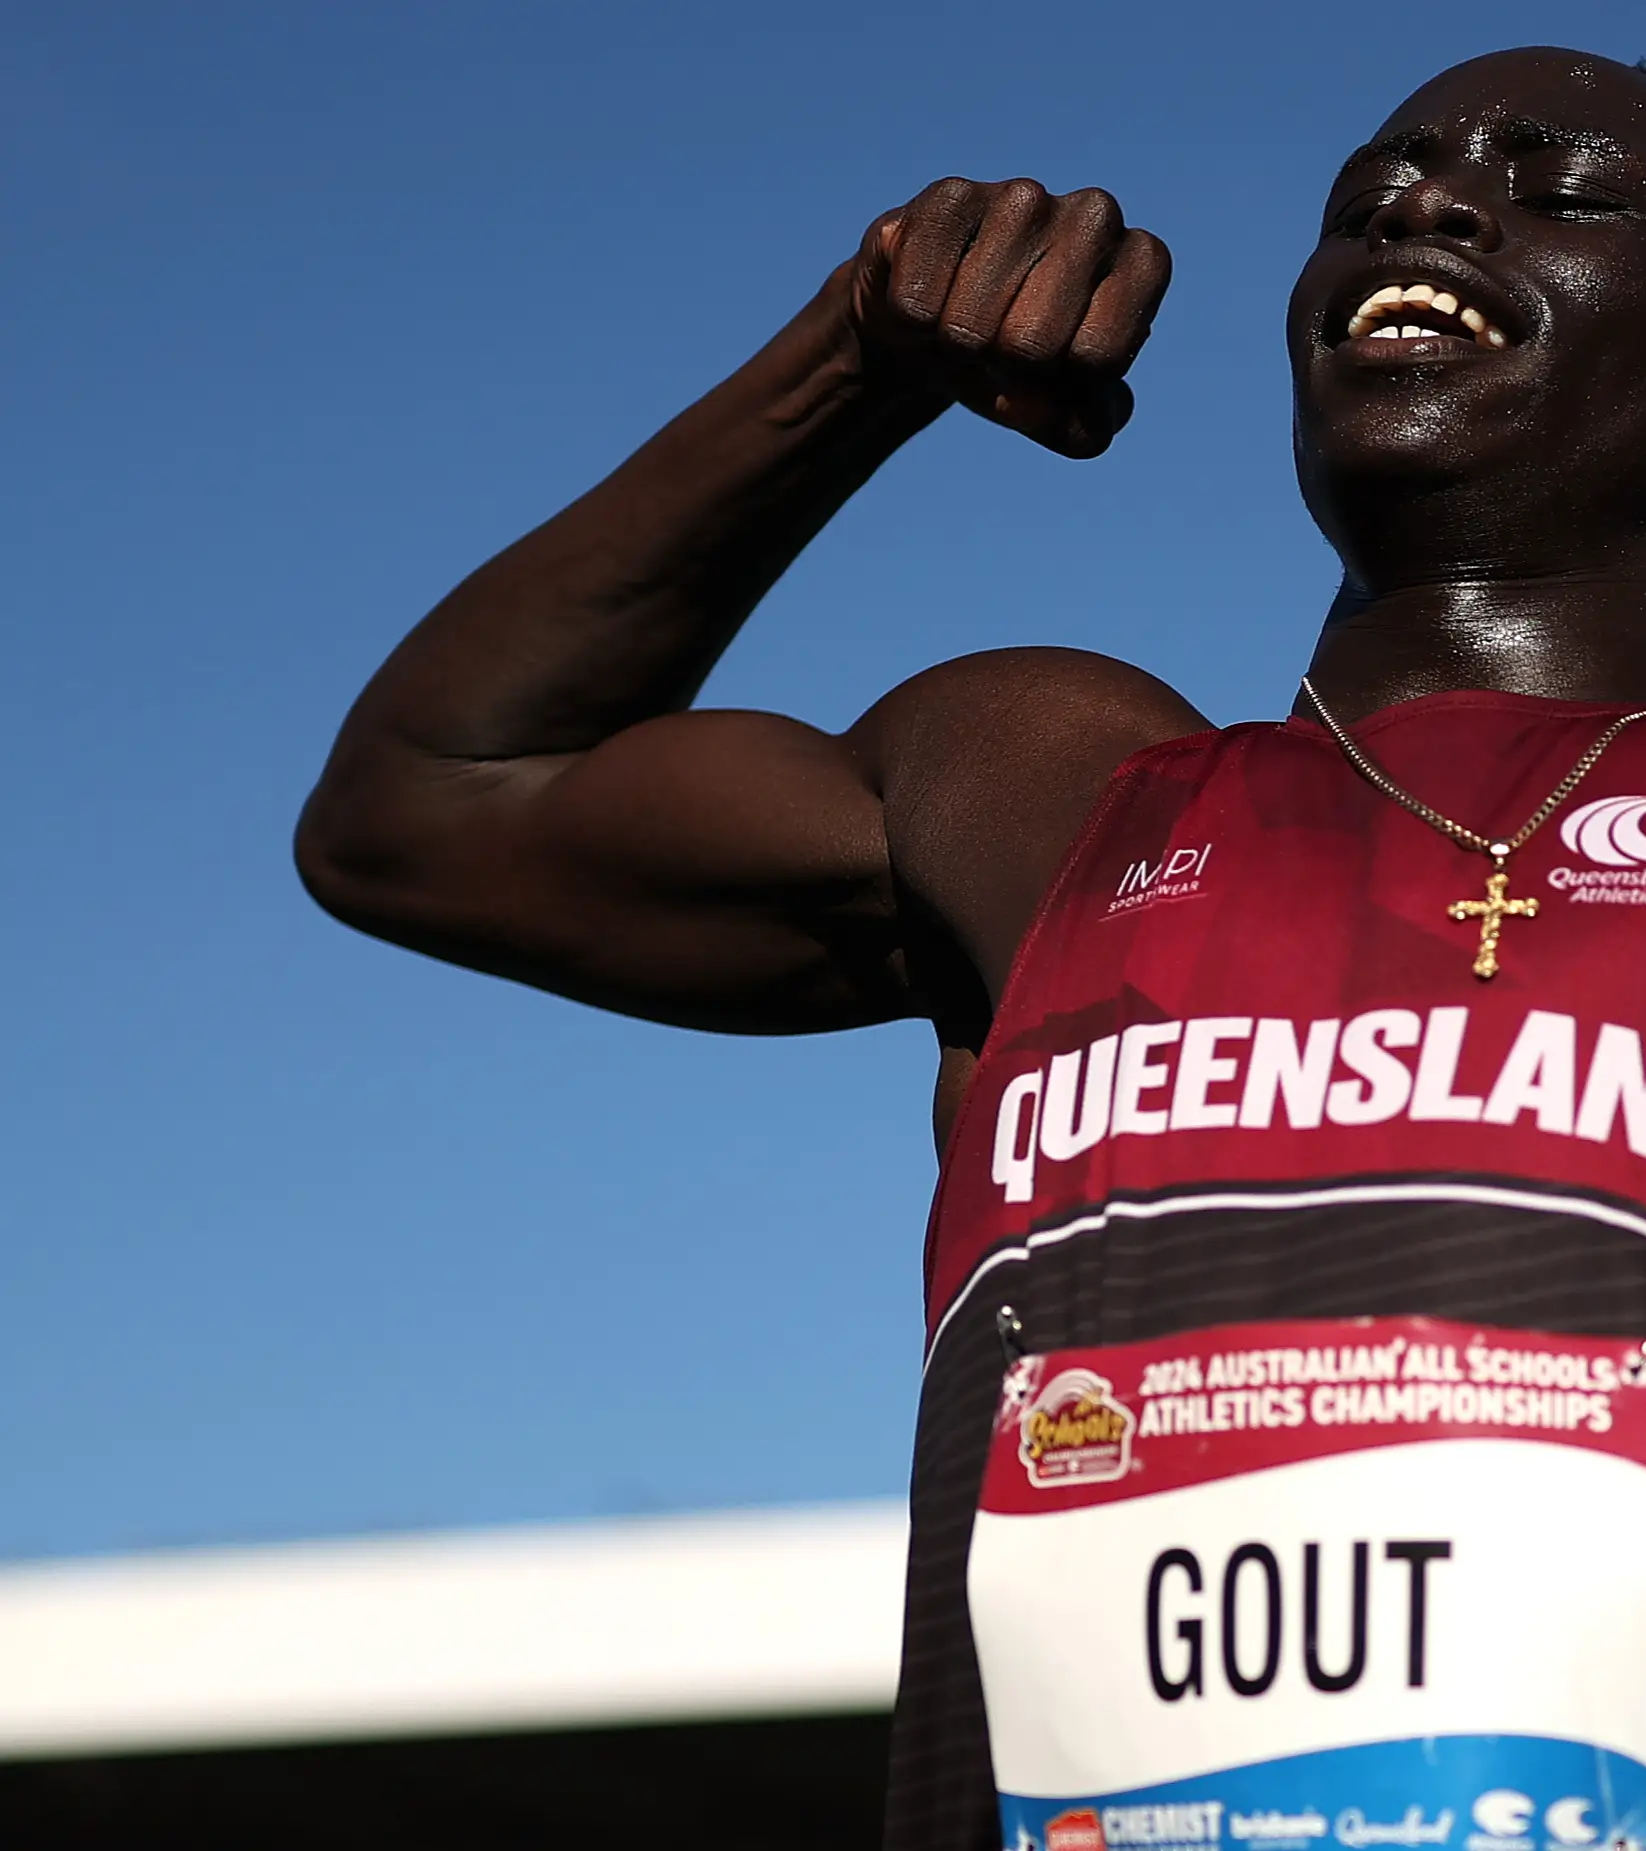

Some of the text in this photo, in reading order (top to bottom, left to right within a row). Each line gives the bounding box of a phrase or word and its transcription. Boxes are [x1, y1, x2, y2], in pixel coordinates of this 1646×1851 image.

[1138, 1343, 1620, 1396] 2024 AUSTRALIAN ALL SCHOOLS
[1138, 1386, 1306, 1438] ATHLETICS
[1311, 1382, 1613, 1433] CHAMPIONSHIPS
[1146, 1540, 1453, 1703] GOUT
[1102, 1801, 1224, 1845] CHEMIST
